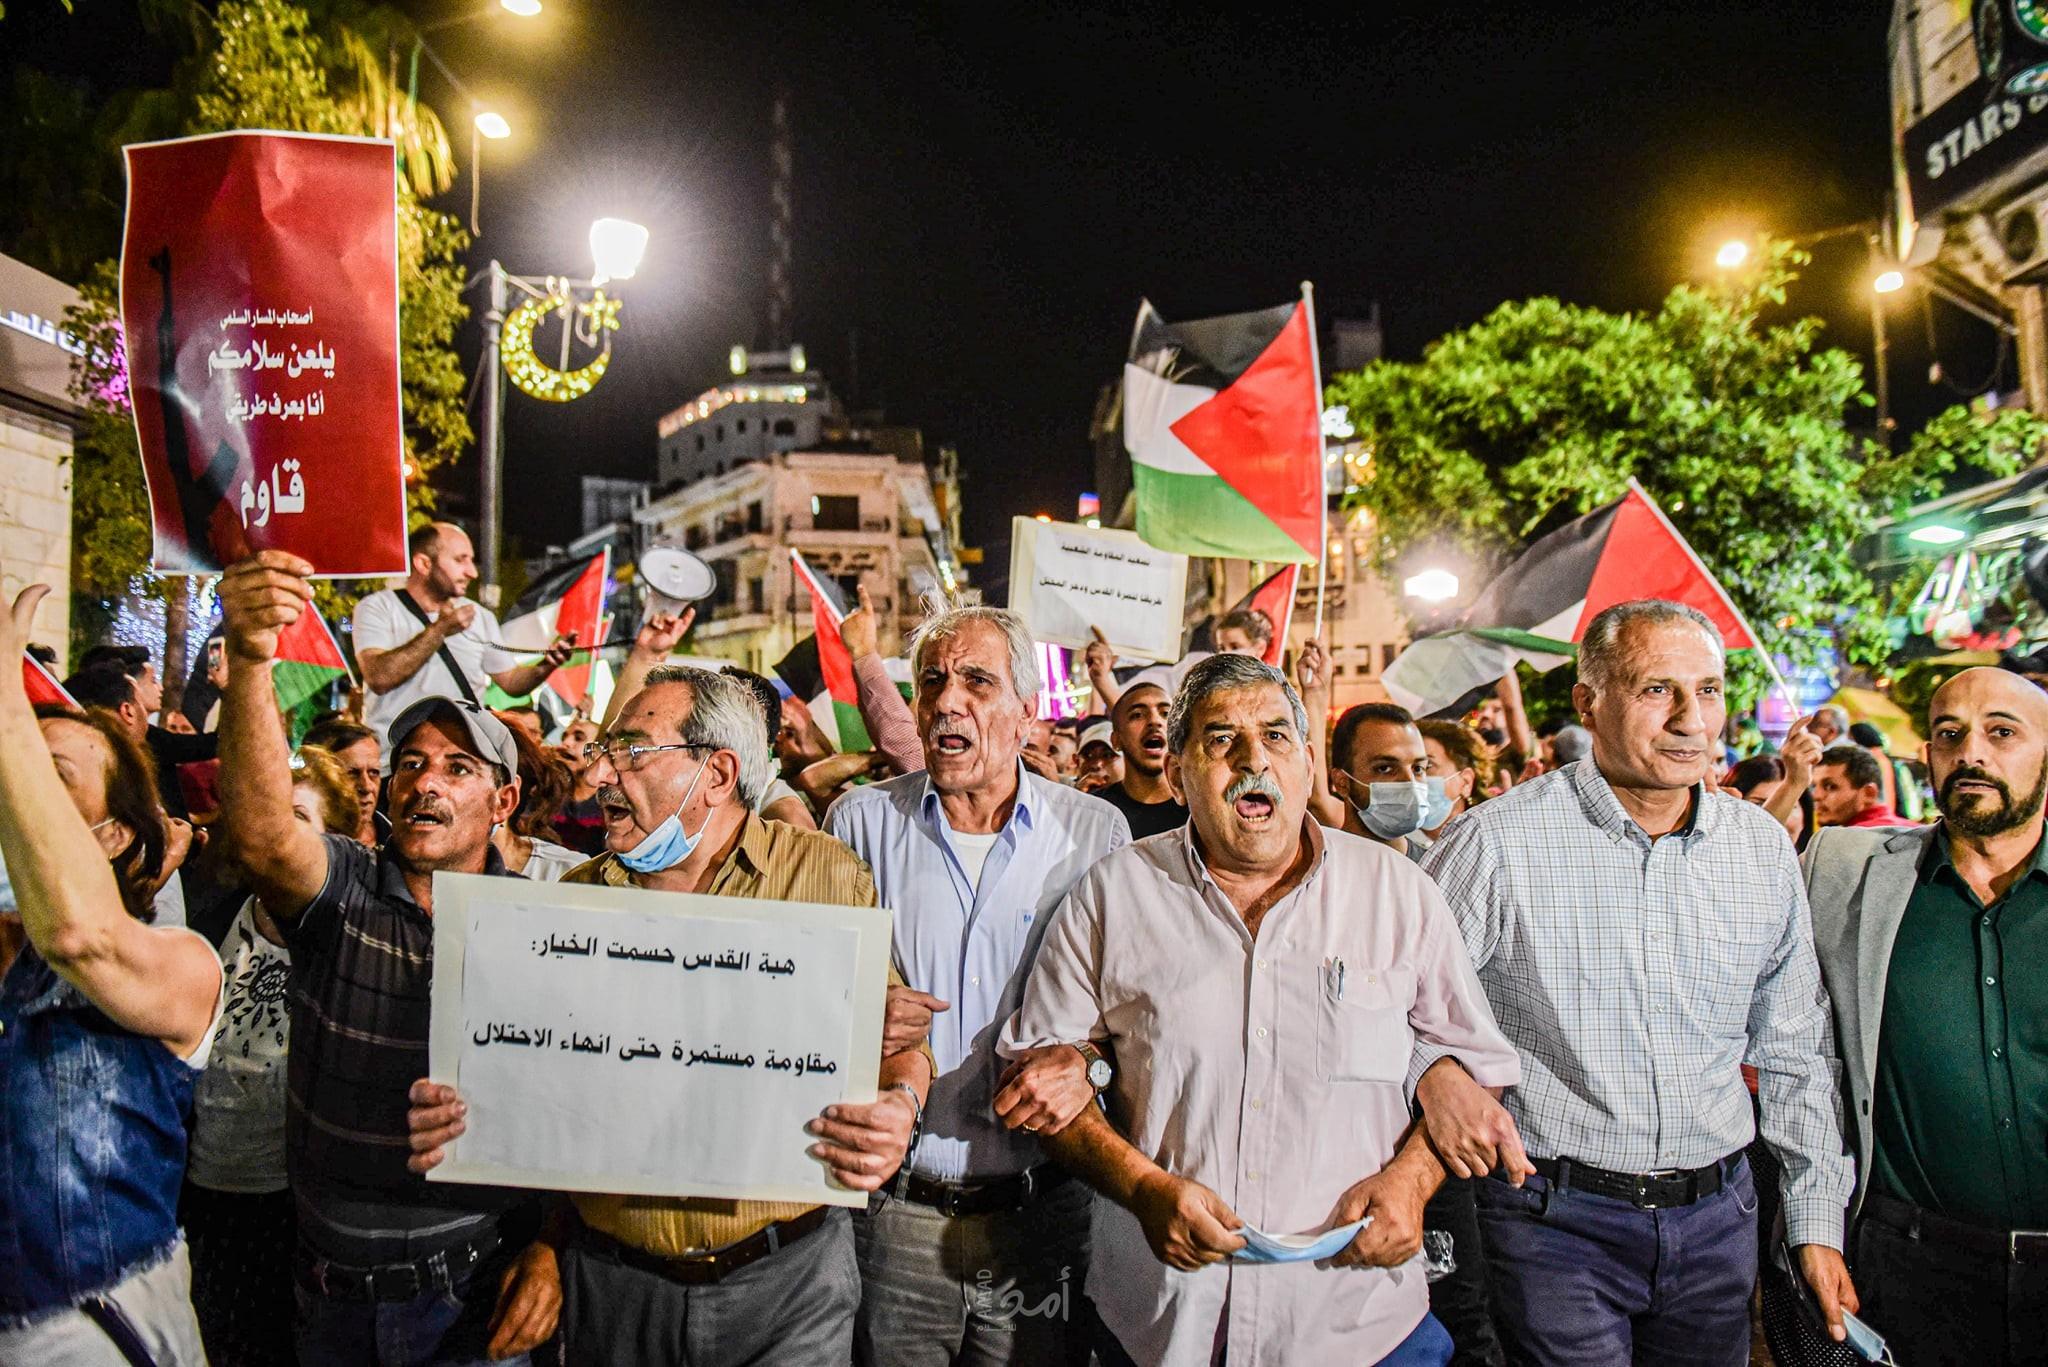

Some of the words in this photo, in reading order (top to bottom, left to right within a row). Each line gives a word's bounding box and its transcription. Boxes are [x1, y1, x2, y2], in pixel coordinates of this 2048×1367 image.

[1925, 99, 2022, 180] STARS
[276, 306, 314, 328] أصحاب
[207, 338, 285, 377] سلامكم
[287, 339, 335, 381] يلعن
[267, 391, 305, 421] بعرف
[307, 389, 325, 417] أنا
[239, 459, 306, 530] قاوم
[531, 932, 598, 960] الخيار:
[606, 940, 676, 966] حسمت
[682, 948, 751, 972] القدس
[758, 951, 796, 980] هبة
[471, 1021, 553, 1051] الاحتلال
[559, 1031, 611, 1056] انهاء
[618, 1036, 662, 1063] حتى
[671, 1039, 756, 1070] مستمرة
[764, 1049, 837, 1078] مقاومة
